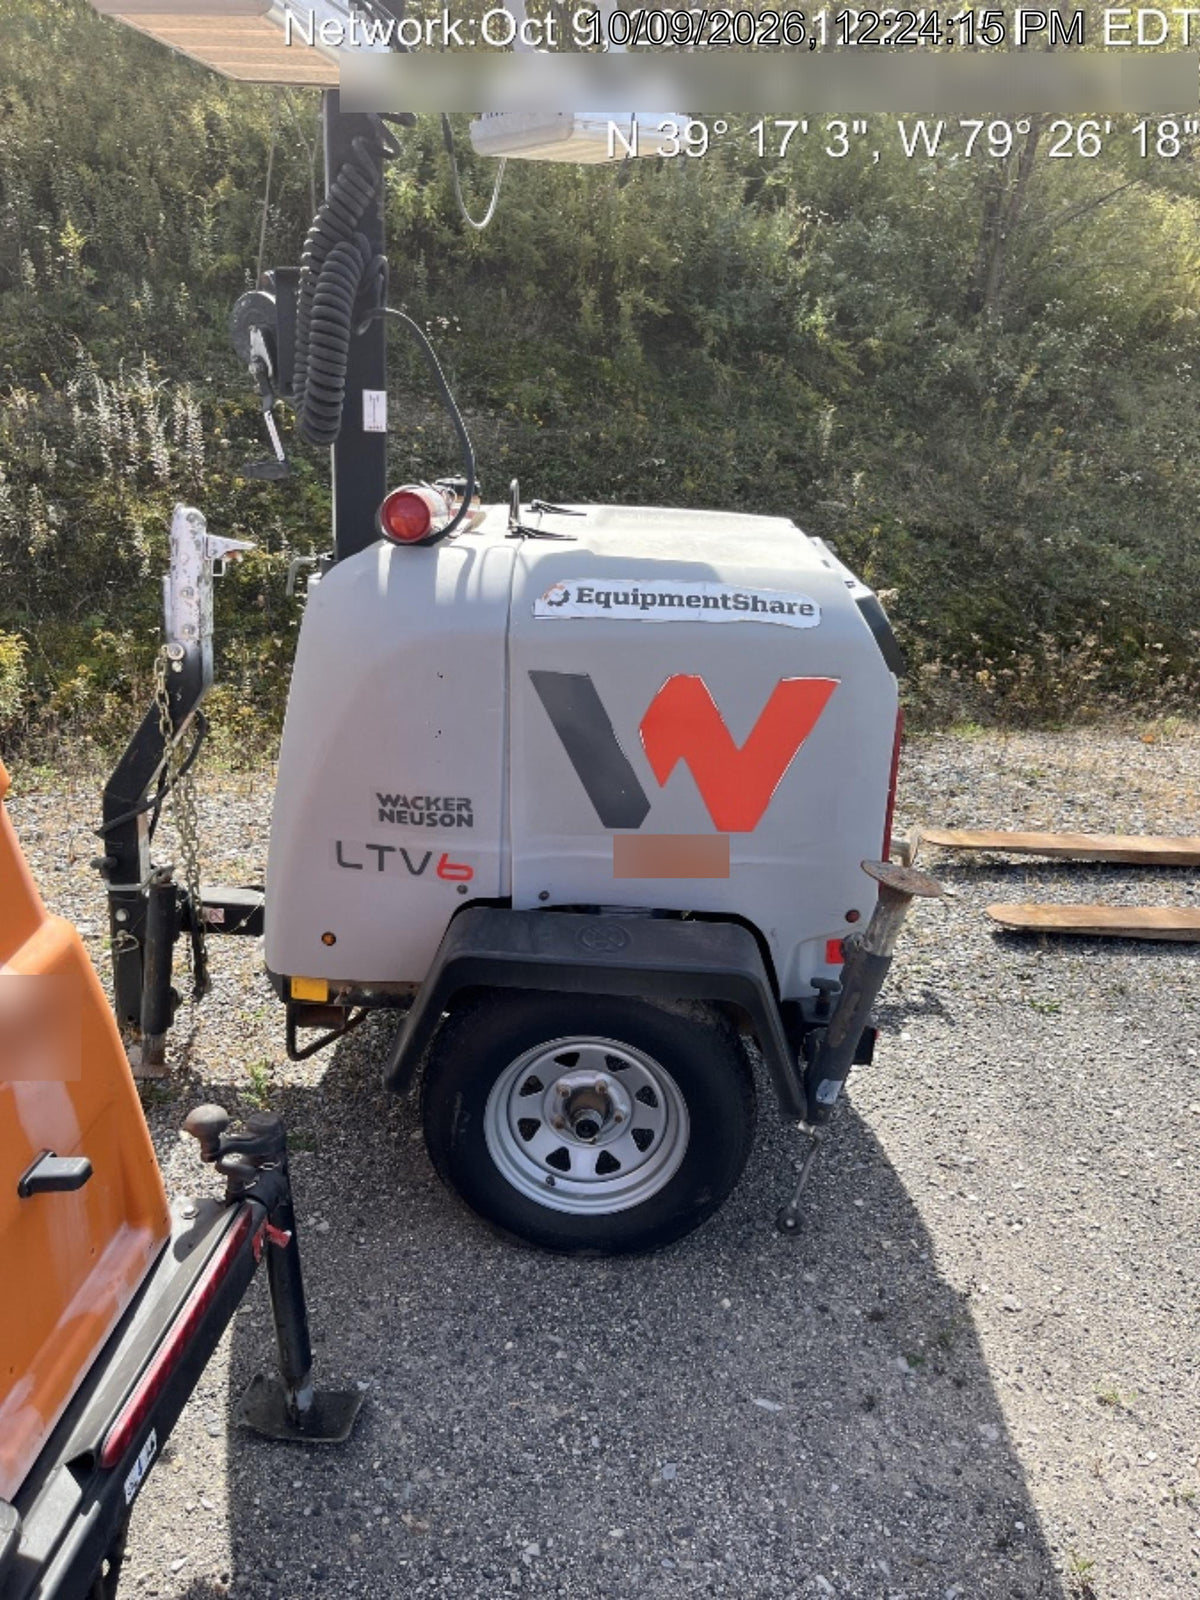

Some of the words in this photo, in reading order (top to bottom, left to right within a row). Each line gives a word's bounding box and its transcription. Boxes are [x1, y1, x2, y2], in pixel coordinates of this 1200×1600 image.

[575, 586, 815, 616] EquipmentShare
[376, 792, 473, 813] WACKER
[378, 808, 474, 828] NEUSON
[335, 840, 475, 882] LTV6
